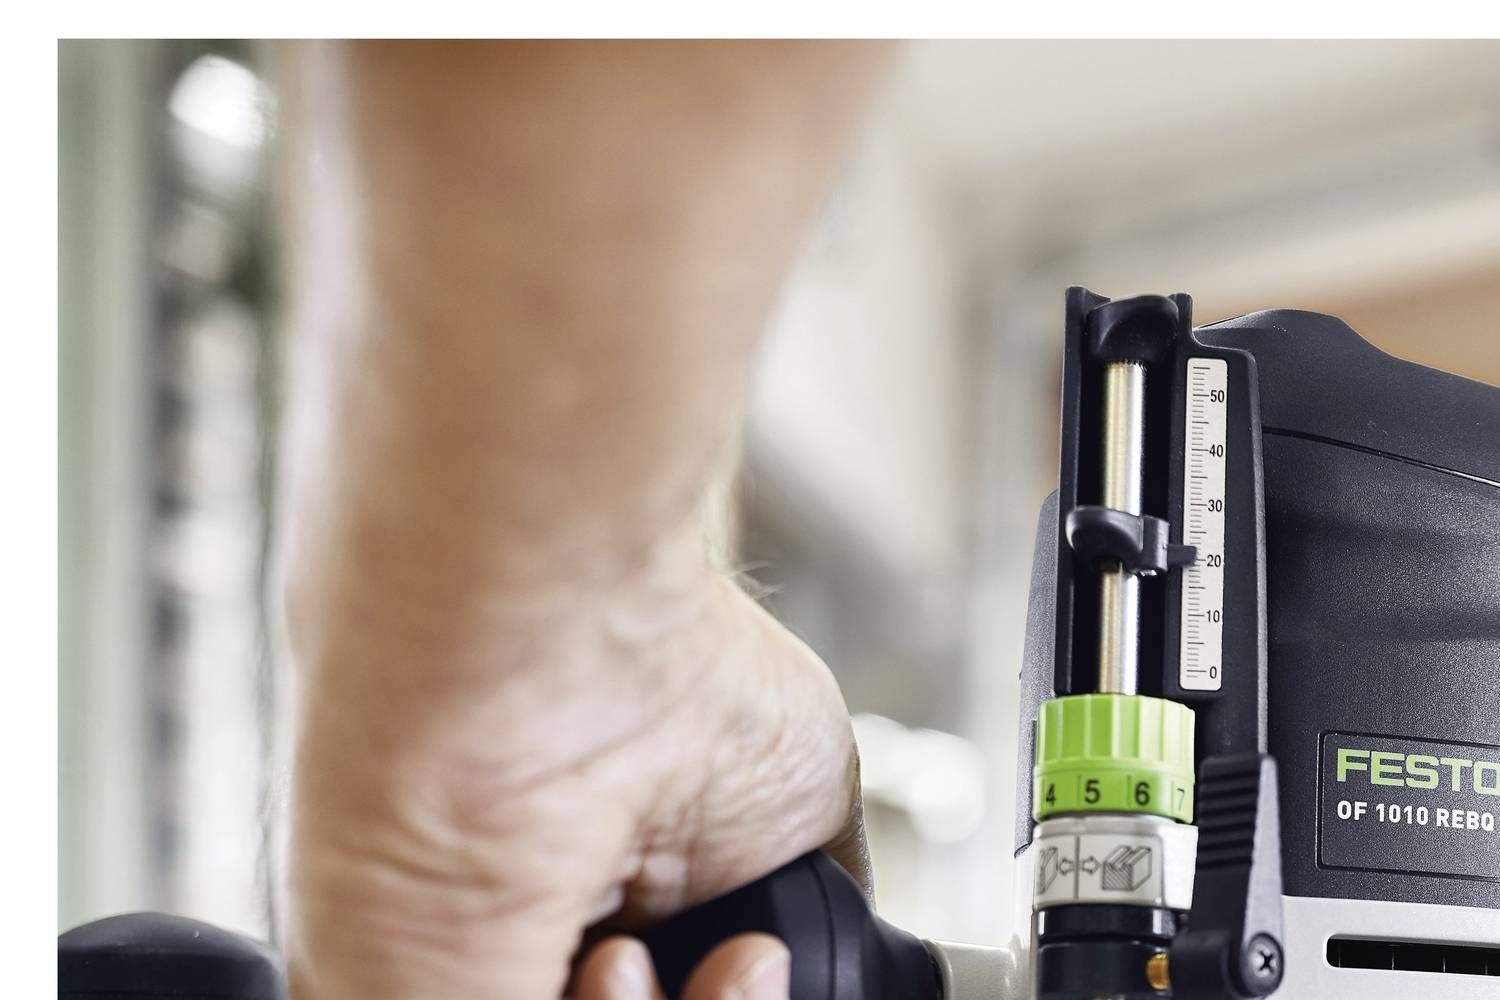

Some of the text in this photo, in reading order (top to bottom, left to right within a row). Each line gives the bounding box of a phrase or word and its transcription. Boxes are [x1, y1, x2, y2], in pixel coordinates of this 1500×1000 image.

[1210, 389, 1225, 403] 50
[1208, 444, 1223, 458] 40
[1208, 499, 1222, 512] 30
[1207, 554, 1221, 568] 20
[1206, 609, 1220, 623] 10
[1209, 666, 1218, 679] 0
[1044, 779, 1185, 811] 4 5 6 7
[1337, 800, 1495, 832] OF 1010 REBQ
